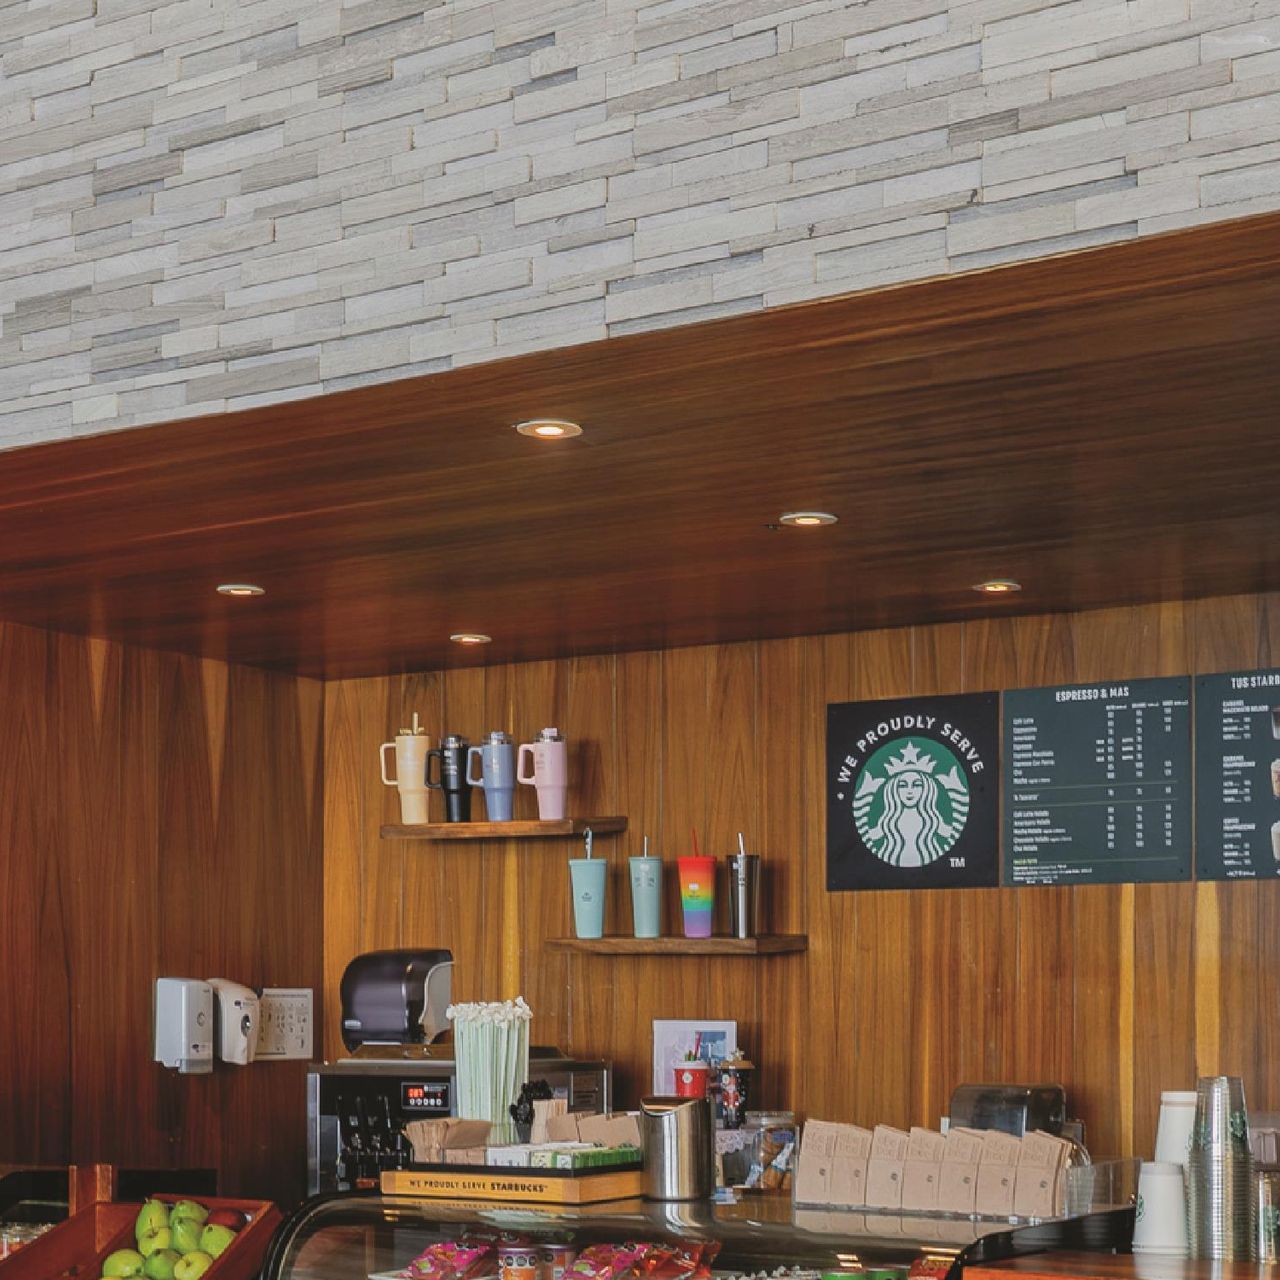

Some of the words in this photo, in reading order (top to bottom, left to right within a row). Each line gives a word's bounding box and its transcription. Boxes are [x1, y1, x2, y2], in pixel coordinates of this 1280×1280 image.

[1231, 677, 1249, 689] TUS
[1056, 690, 1099, 702] ESPRESSO
[837, 755, 858, 783] WE
[856, 715, 935, 752] PROUDLY
[941, 723, 984, 773] SERVE
[424, 1181, 459, 1189] PROUDLY
[462, 1182, 486, 1190] SERVE
